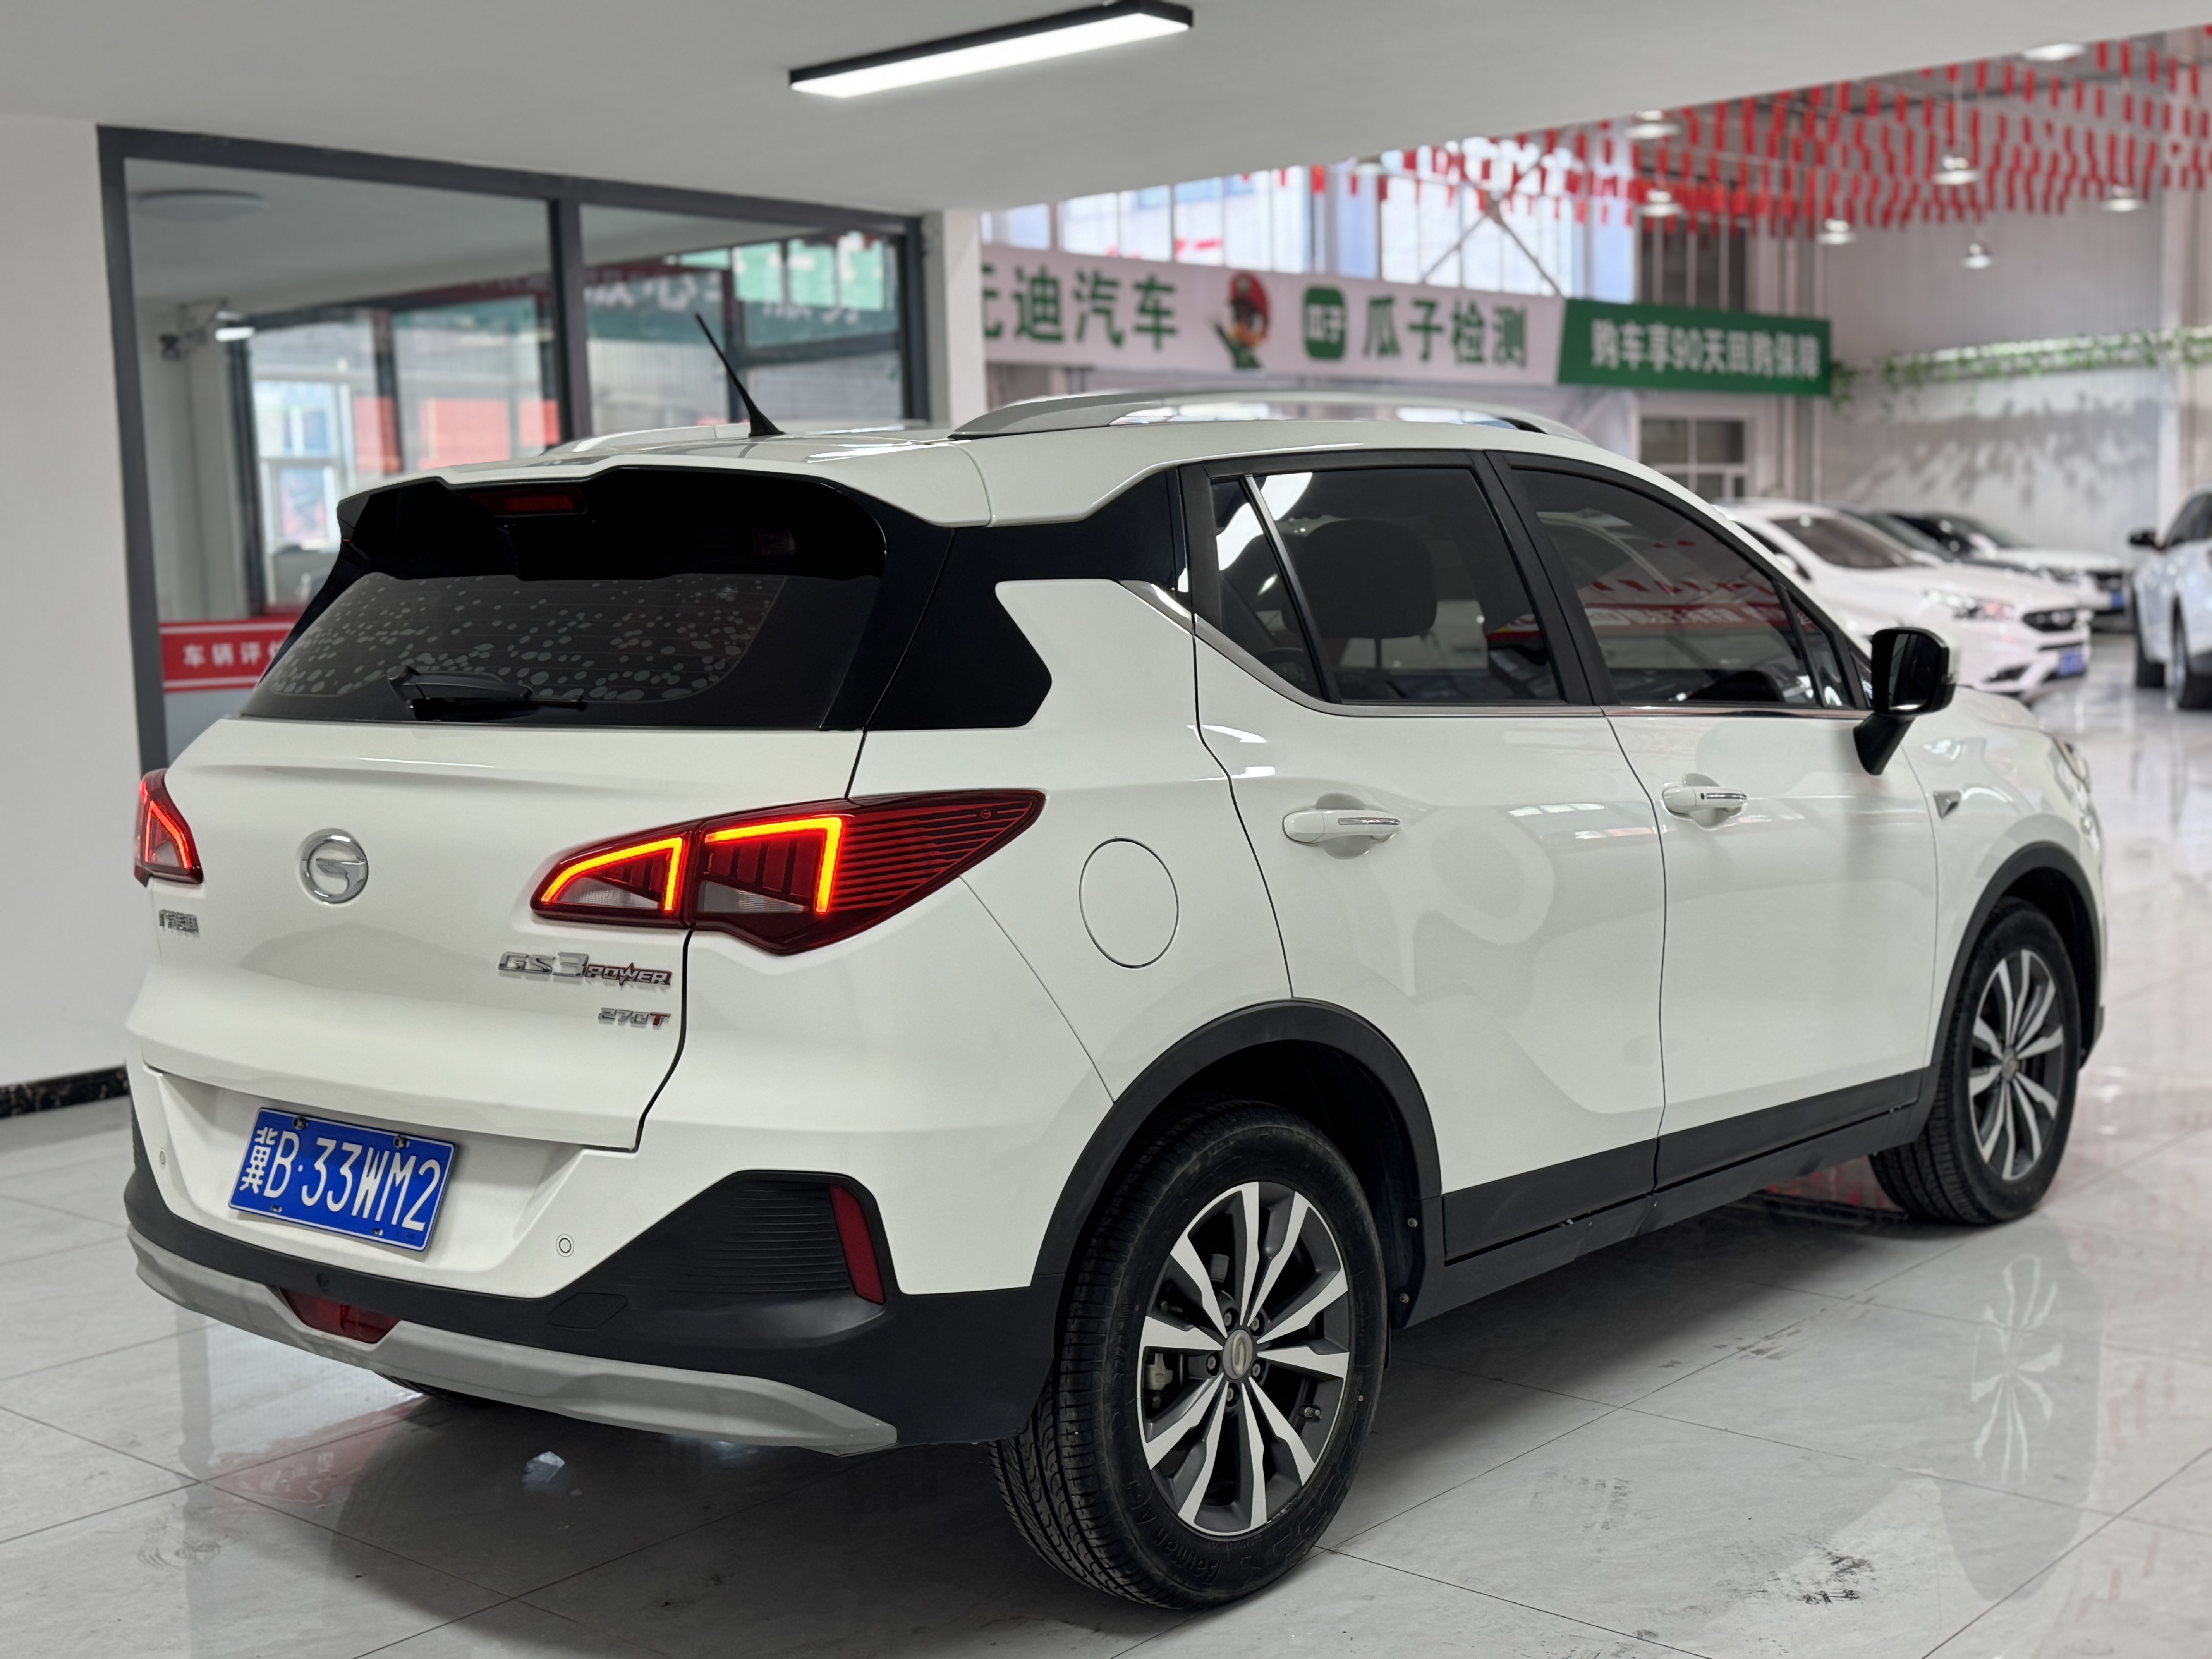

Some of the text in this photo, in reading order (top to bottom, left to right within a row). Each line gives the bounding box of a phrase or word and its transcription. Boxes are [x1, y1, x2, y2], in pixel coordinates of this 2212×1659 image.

[1362, 295, 1527, 369] 瓜子检测
[498, 951, 672, 986] GS3 POWER
